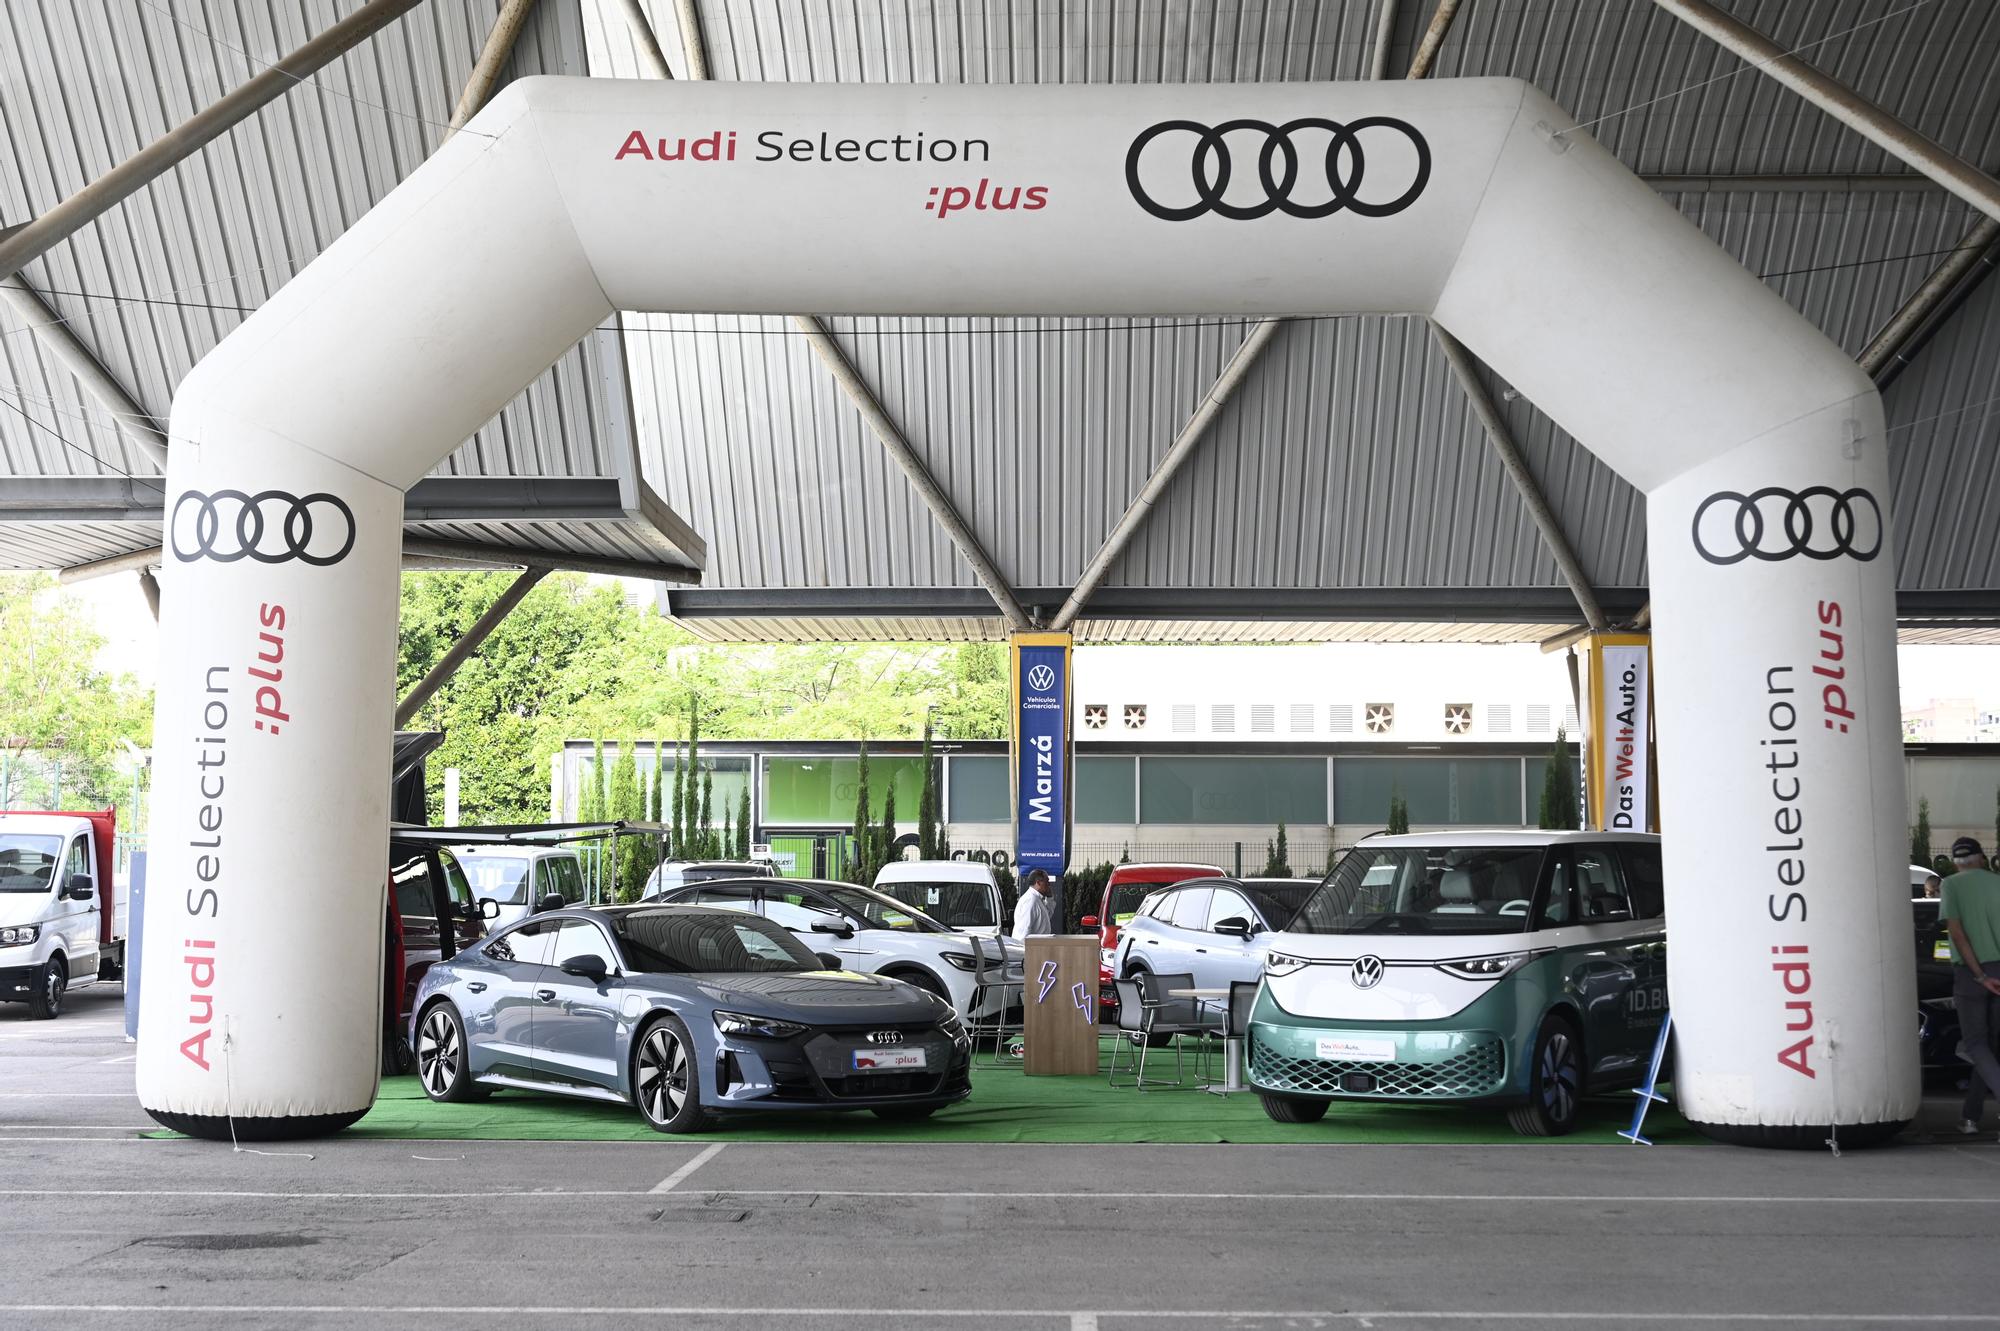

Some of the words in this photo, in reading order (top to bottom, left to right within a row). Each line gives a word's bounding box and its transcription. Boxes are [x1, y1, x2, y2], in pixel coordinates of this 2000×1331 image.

[615, 130, 737, 161] Audi
[755, 130, 989, 162] Selection
[926, 178, 1049, 219] :plus
[247, 603, 290, 735] :plus
[1023, 702, 1061, 710] Comerciales
[1812, 599, 1856, 734] :plus
[187, 666, 230, 918] Selection
[1029, 735, 1053, 823] Marzá
[1613, 785, 1634, 829] Das
[1760, 666, 1807, 922] Selection
[180, 939, 216, 1071] Audi
[1770, 946, 1817, 1079] Audi
